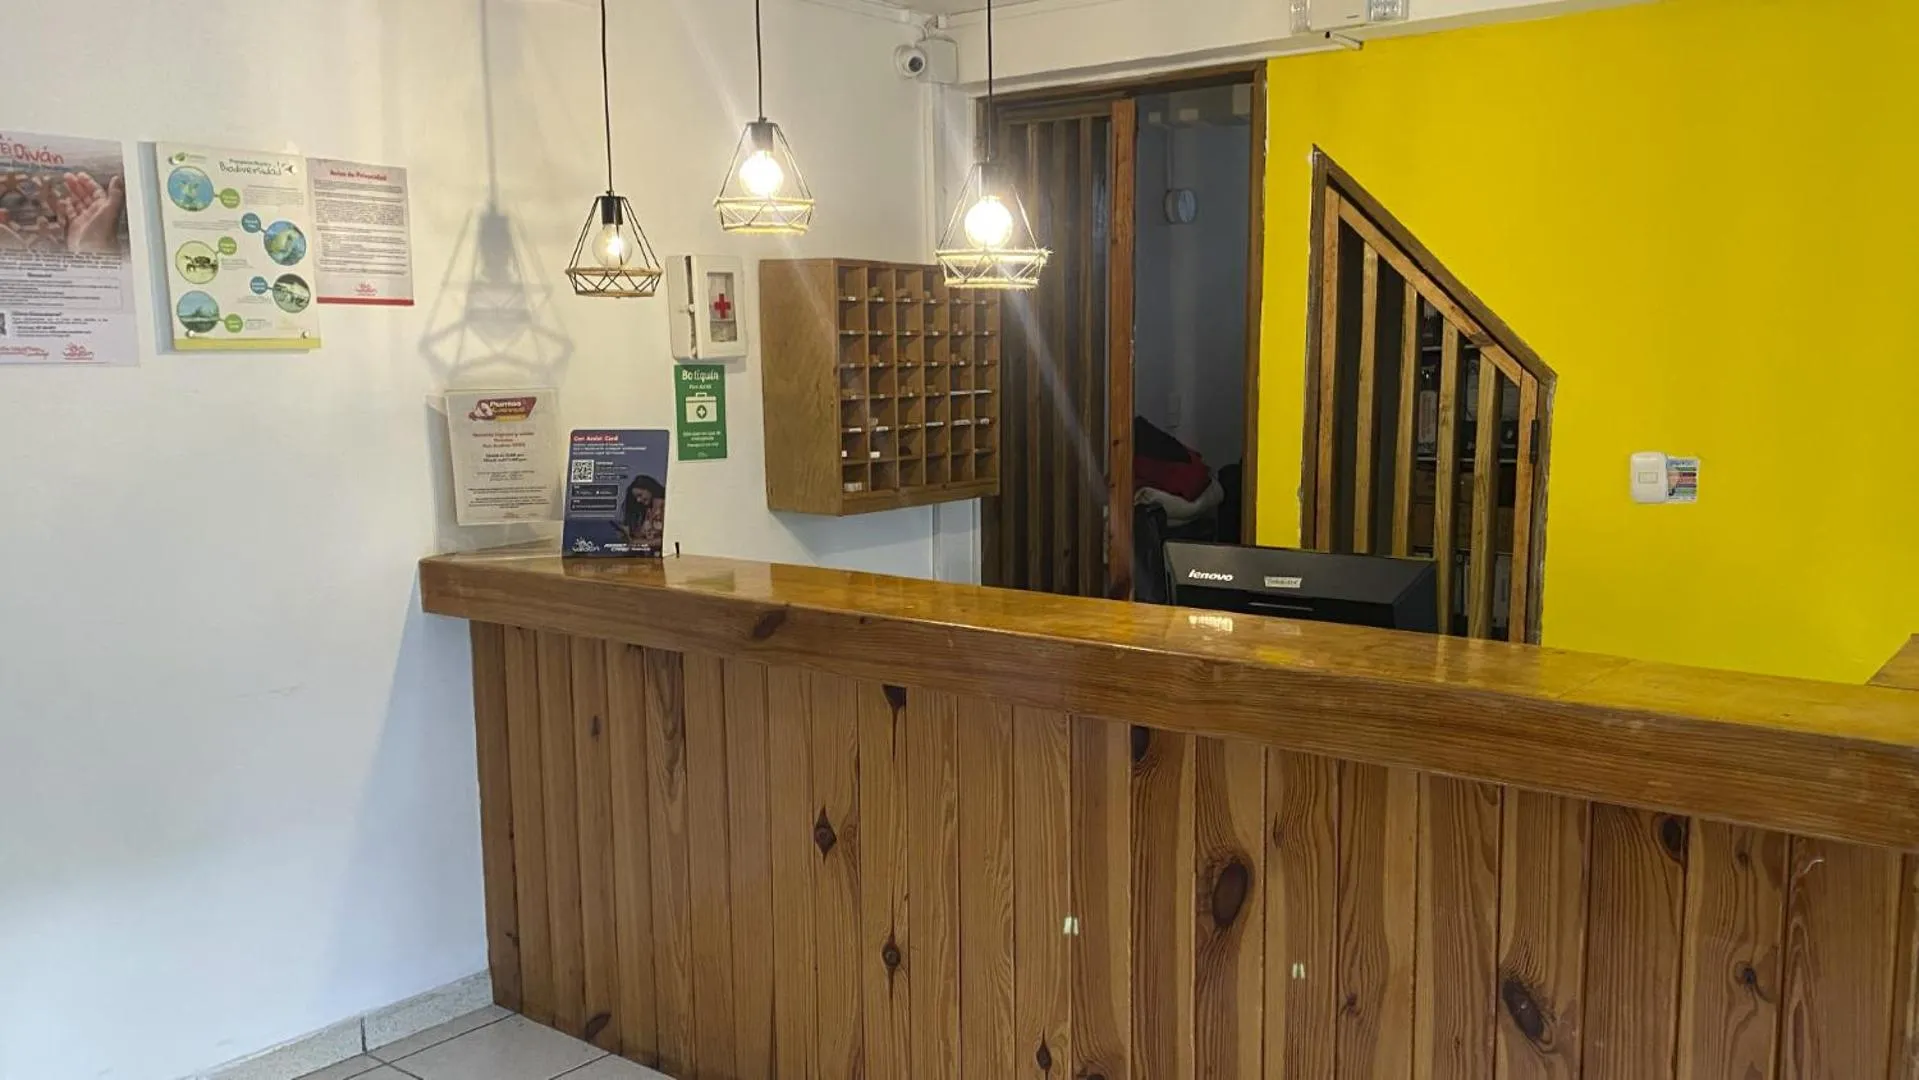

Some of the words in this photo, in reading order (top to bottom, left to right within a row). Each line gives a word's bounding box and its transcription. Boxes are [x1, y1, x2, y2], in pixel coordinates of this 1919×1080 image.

[13, 143, 65, 165] Diván
[219, 161, 283, 176] Biodiversidad
[682, 369, 719, 383] Botiquín
[1187, 568, 1234, 582] lenovo
